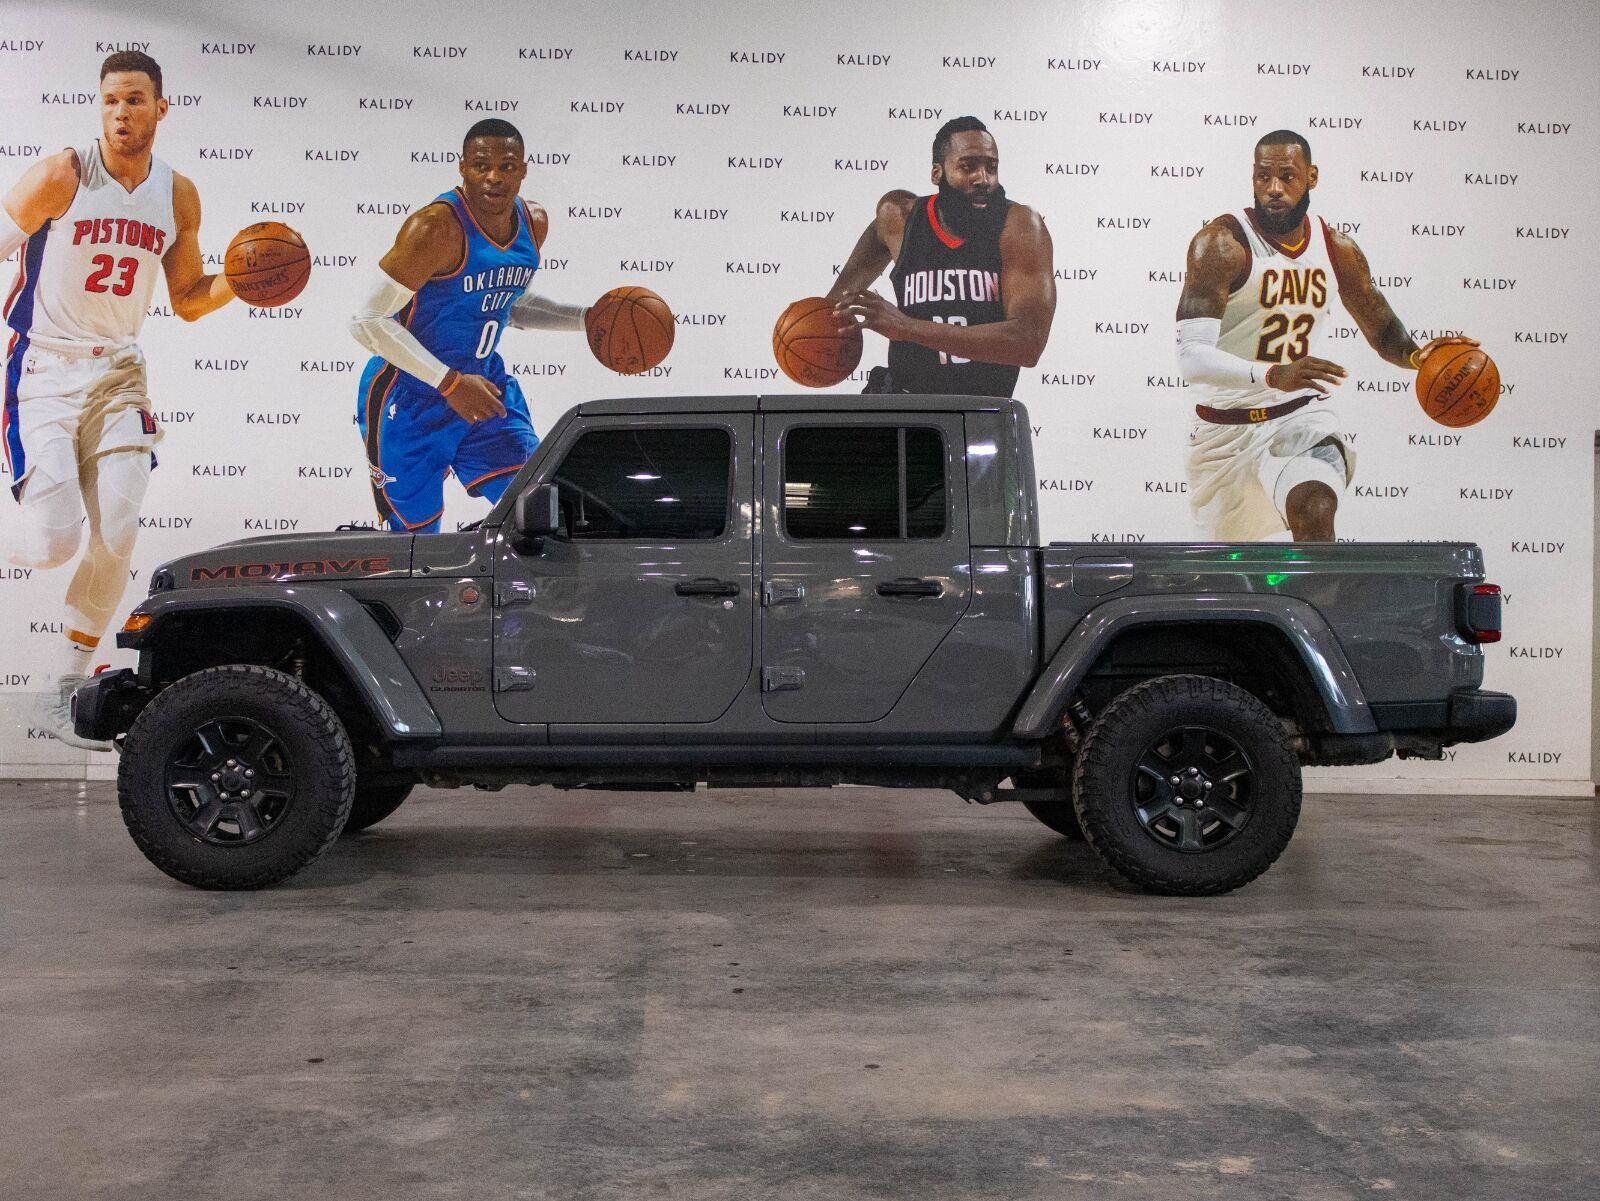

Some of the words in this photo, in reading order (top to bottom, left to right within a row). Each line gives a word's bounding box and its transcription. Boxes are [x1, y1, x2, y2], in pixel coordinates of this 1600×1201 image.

[0, 41, 44, 51] ALIDY
[201, 44, 256, 54] KALIDY
[307, 45, 362, 55] KALIDY
[413, 47, 468, 57] KALIDY
[519, 49, 573, 59] KALIDY
[624, 50, 678, 61] KALIDY
[730, 52, 786, 63] KALIDY
[837, 54, 891, 65] KALIDY
[942, 57, 996, 67] KALIDY
[1047, 59, 1101, 70] KALIDY
[1153, 62, 1206, 72] KALIDY
[1257, 64, 1311, 75] KALIDY
[1362, 67, 1415, 77] KALIDY
[1466, 69, 1520, 80] KALIDY
[42, 94, 96, 104] KALIDY
[169, 96, 202, 106] LIDY
[253, 97, 308, 107] KALIDY
[359, 99, 413, 109] KALIDY
[465, 100, 519, 111] KALIDY
[570, 102, 625, 112] KALIDY
[676, 104, 731, 114] KALIDY
[783, 106, 837, 116] KALIDY
[888, 108, 943, 119] KALIDY
[994, 110, 1048, 121] KALIDY
[1099, 113, 1153, 123] KALIDY
[1204, 115, 1258, 126] KALIDY
[1309, 118, 1363, 128] KALIDY
[1413, 121, 1467, 131] KALIDY
[1517, 123, 1571, 134] KALIDY
[0, 146, 42, 156] ALIDY
[199, 149, 254, 159] KALIDY
[305, 150, 360, 160] KALIDY
[527, 154, 571, 165] ALIDY
[622, 155, 677, 166] KALIDY
[728, 157, 783, 168] KALIDY
[834, 160, 889, 170] KALIDY
[1045, 164, 1100, 175] KALIDY
[1151, 166, 1204, 177] KALIDY
[1360, 171, 1414, 182] KALIDY
[1465, 174, 1518, 185] KALIDY
[251, 202, 305, 213] KALIDY
[356, 204, 411, 215] KALIDY
[568, 207, 623, 217] KALIDY
[674, 209, 729, 219] KALIDY
[780, 211, 835, 222] KALIDY
[1097, 218, 1151, 228] KALIDY
[1412, 225, 1465, 235] KALIDY
[1516, 228, 1570, 238] KALIDY
[72, 218, 166, 256] PISTONS
[312, 256, 357, 267] ALIDY
[620, 261, 674, 271] KALIDY
[726, 263, 781, 273] KALIDY
[85, 253, 139, 297] 23
[463, 266, 533, 293] OKLAHOM
[1053, 270, 1097, 281] ALIDY
[1149, 271, 1182, 282] KALI
[904, 268, 999, 307] HOUSTON
[1371, 277, 1412, 288] ALIDY
[1463, 279, 1517, 289] KALIDY
[1259, 268, 1327, 309] CAVS
[481, 291, 514, 313] CITY
[248, 307, 303, 318] KALIDY
[1095, 323, 1149, 333] KALIDY
[475, 320, 499, 359] 0
[1256, 313, 1315, 364] 23
[1514, 332, 1568, 343] KALIDY
[194, 360, 249, 370] KALIDY
[300, 361, 355, 371] KALIDY
[512, 365, 567, 375] KALIDY
[724, 368, 779, 379] KALIDY
[1041, 374, 1096, 385] KALIDY
[1357, 381, 1411, 392] KALIDY
[153, 411, 195, 423] ALIDY
[246, 413, 301, 424] KALIDY
[1249, 408, 1268, 422] CLE
[1093, 428, 1147, 439] KALIDY
[1408, 435, 1462, 445] KALIDY
[1513, 437, 1567, 448] KALIDY
[192, 465, 247, 476] KALIDY
[298, 467, 353, 477] KALIDY
[1039, 480, 1094, 490] KALIDY
[1355, 486, 1409, 497] KALIDY
[1460, 489, 1513, 499] KALIDY
[138, 518, 193, 528] KALIDY
[244, 519, 299, 530] KALIDY
[1511, 542, 1565, 553] KALIDY
[0, 569, 32, 579] LIDY
[190, 557, 389, 583] MOJAVE
[30, 622, 63, 633] KALI
[1510, 647, 1564, 658] KALIDY
[1508, 752, 1562, 763] KALIDY
